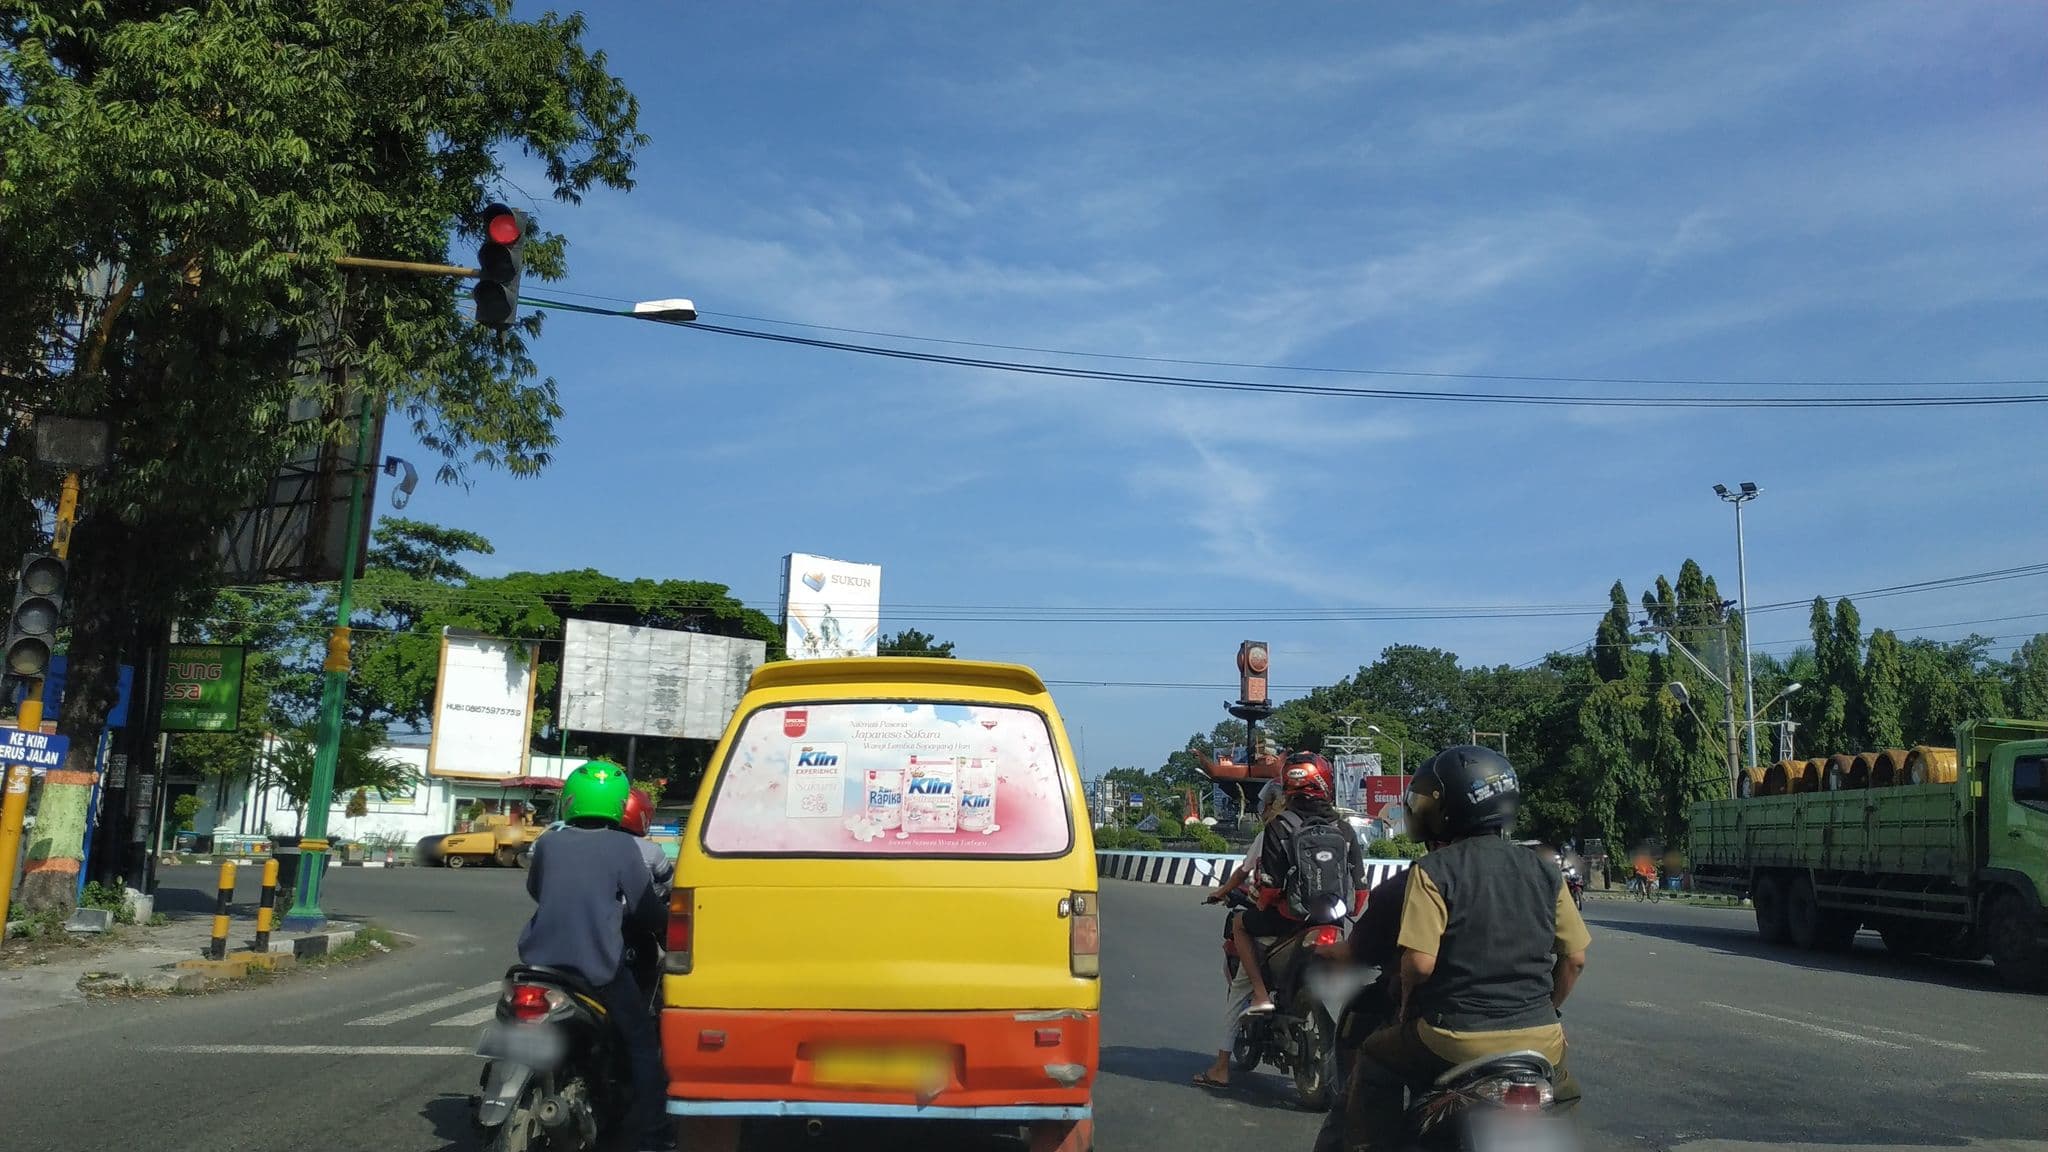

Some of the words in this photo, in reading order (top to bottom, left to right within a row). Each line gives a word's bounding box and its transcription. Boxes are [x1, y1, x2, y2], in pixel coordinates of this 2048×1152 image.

[831, 574, 871, 588] SUKUN
[10, 732, 24, 745] KE
[26, 733, 49, 748] KIRI
[903, 728, 941, 739] Sakura
[26, 749, 59, 765] JALAN
[798, 751, 839, 767] Klin
[908, 777, 954, 795] Klin
[869, 790, 902, 805] Rapika
[961, 794, 991, 808] Klin
